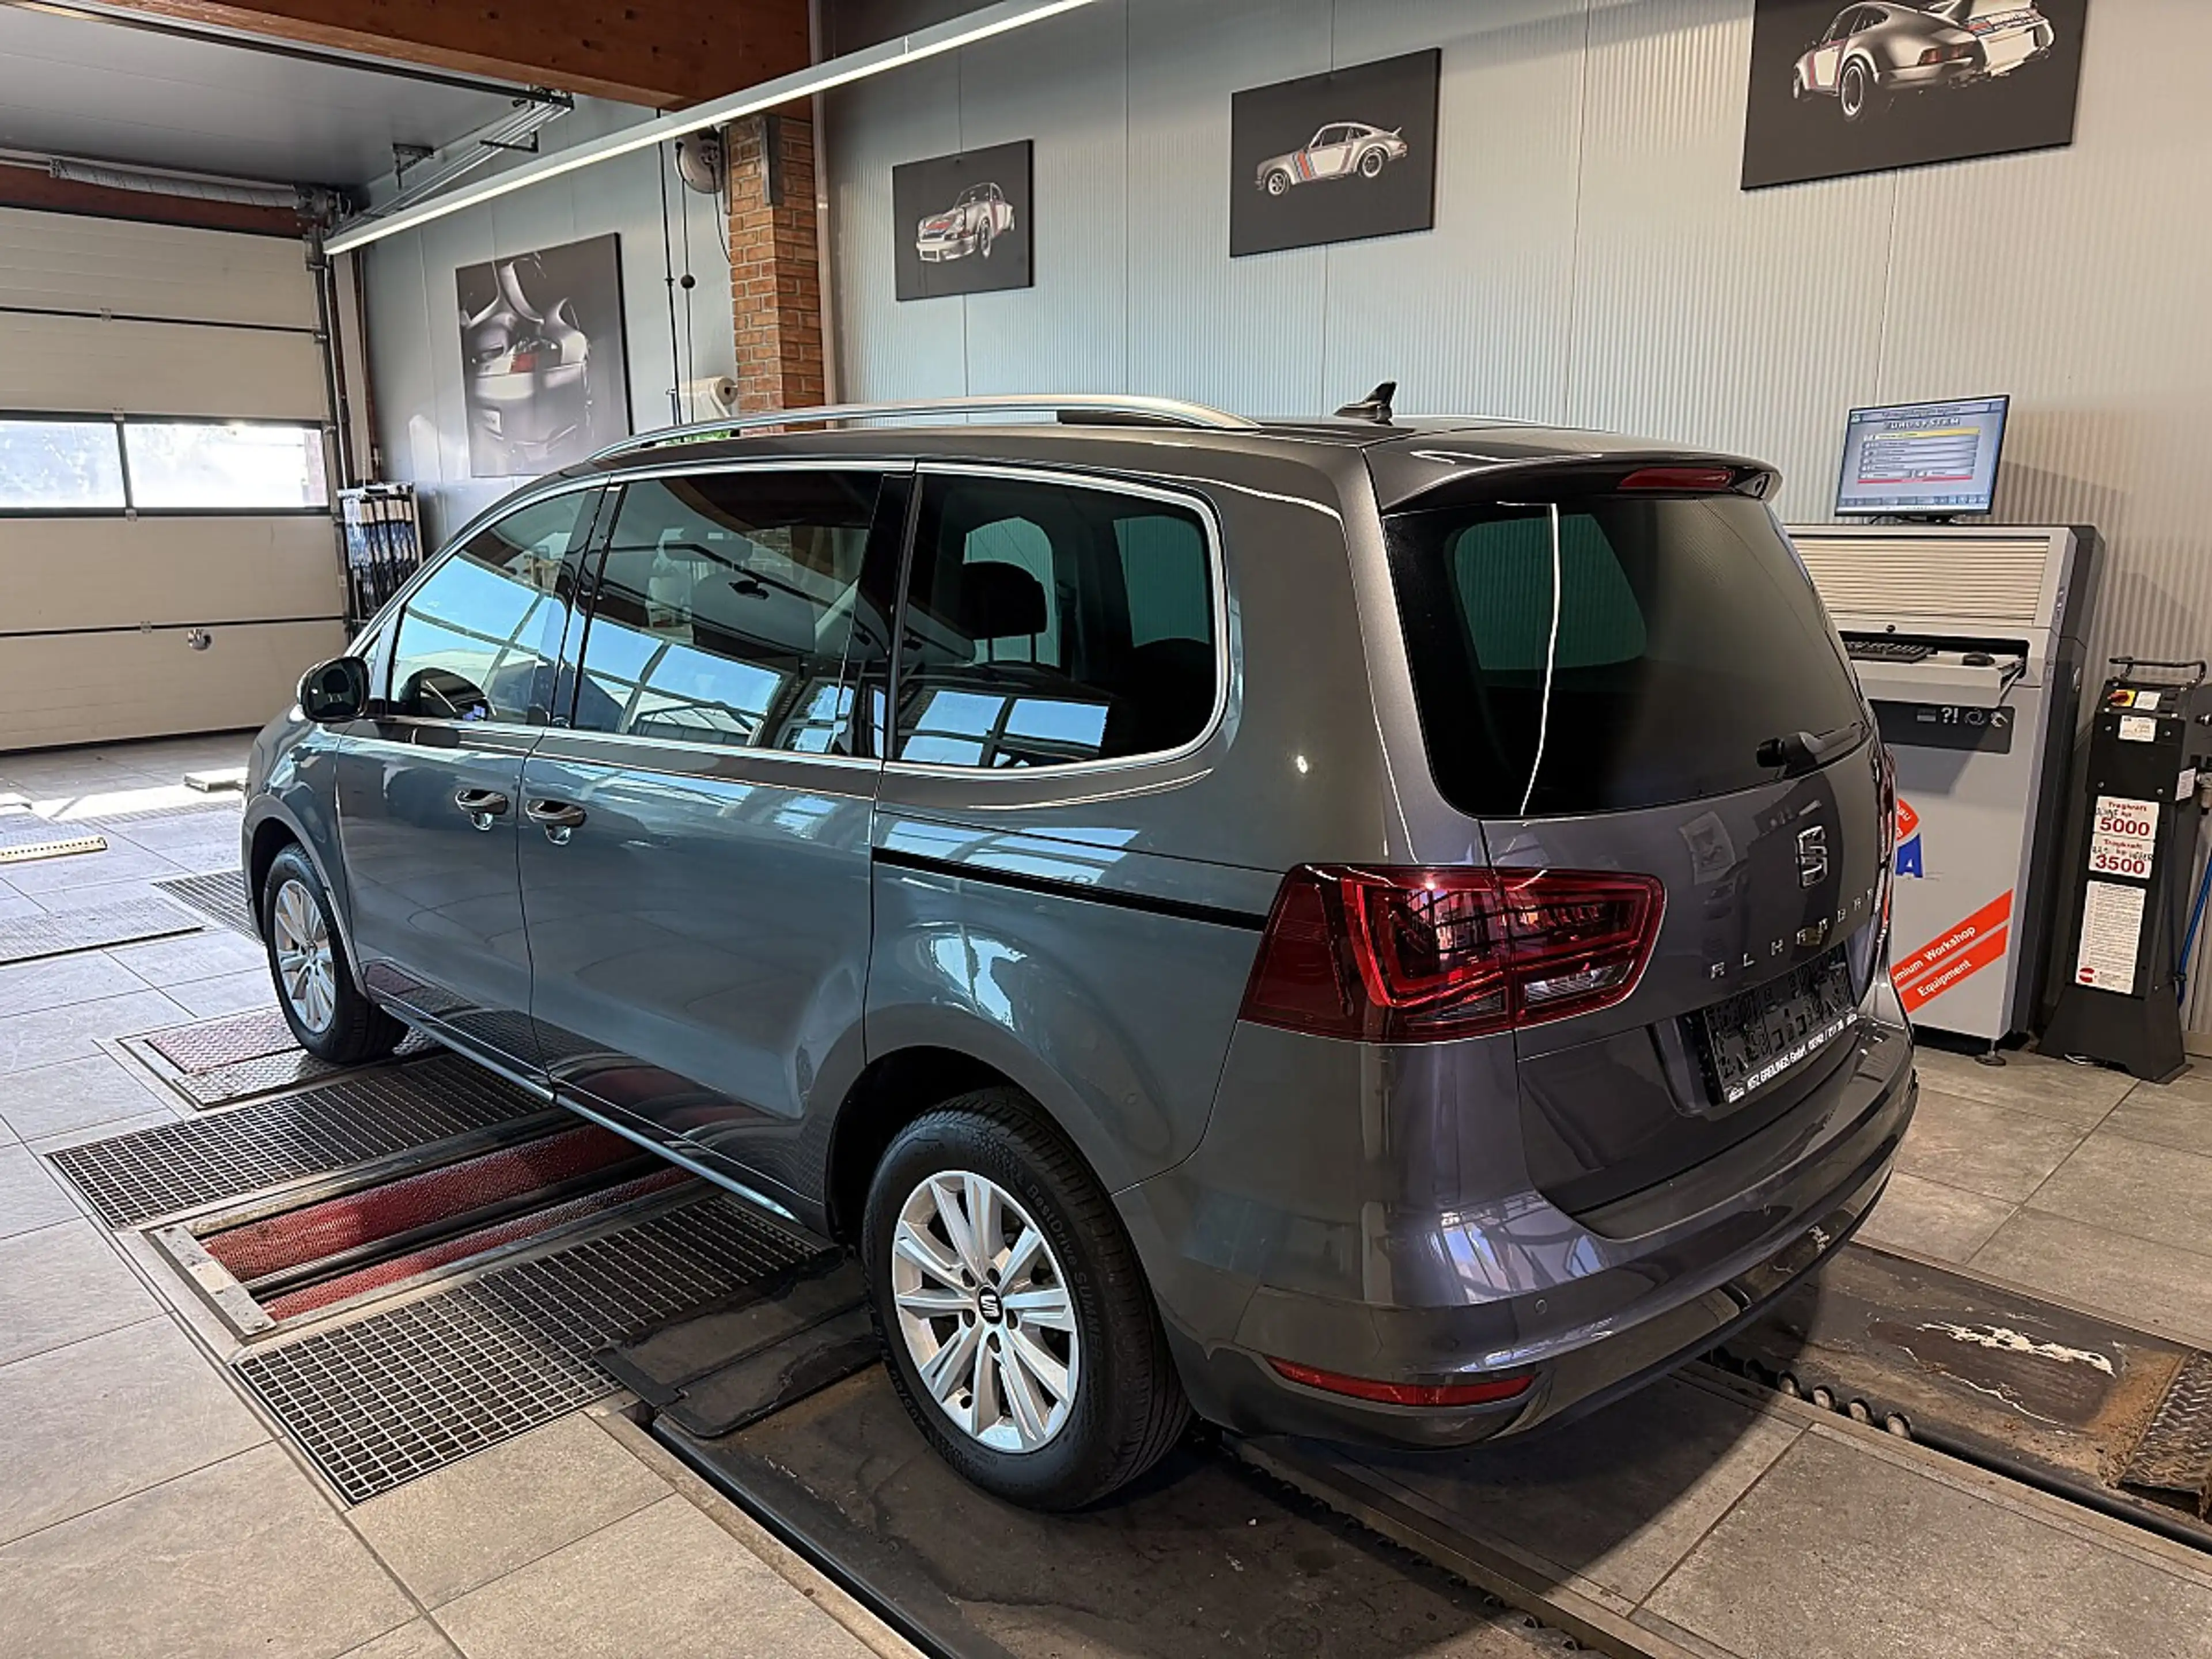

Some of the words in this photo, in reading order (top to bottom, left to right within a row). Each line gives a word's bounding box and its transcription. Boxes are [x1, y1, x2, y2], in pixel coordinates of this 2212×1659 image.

[2100, 817, 2150, 836] 5000
[2095, 853, 2145, 874] 3500
[1923, 926, 1976, 961] Workshop
[1916, 959, 1972, 997] Equipment
[1027, 1184, 1078, 1266] BestDrive
[1074, 1272, 1104, 1362] SUMMER
